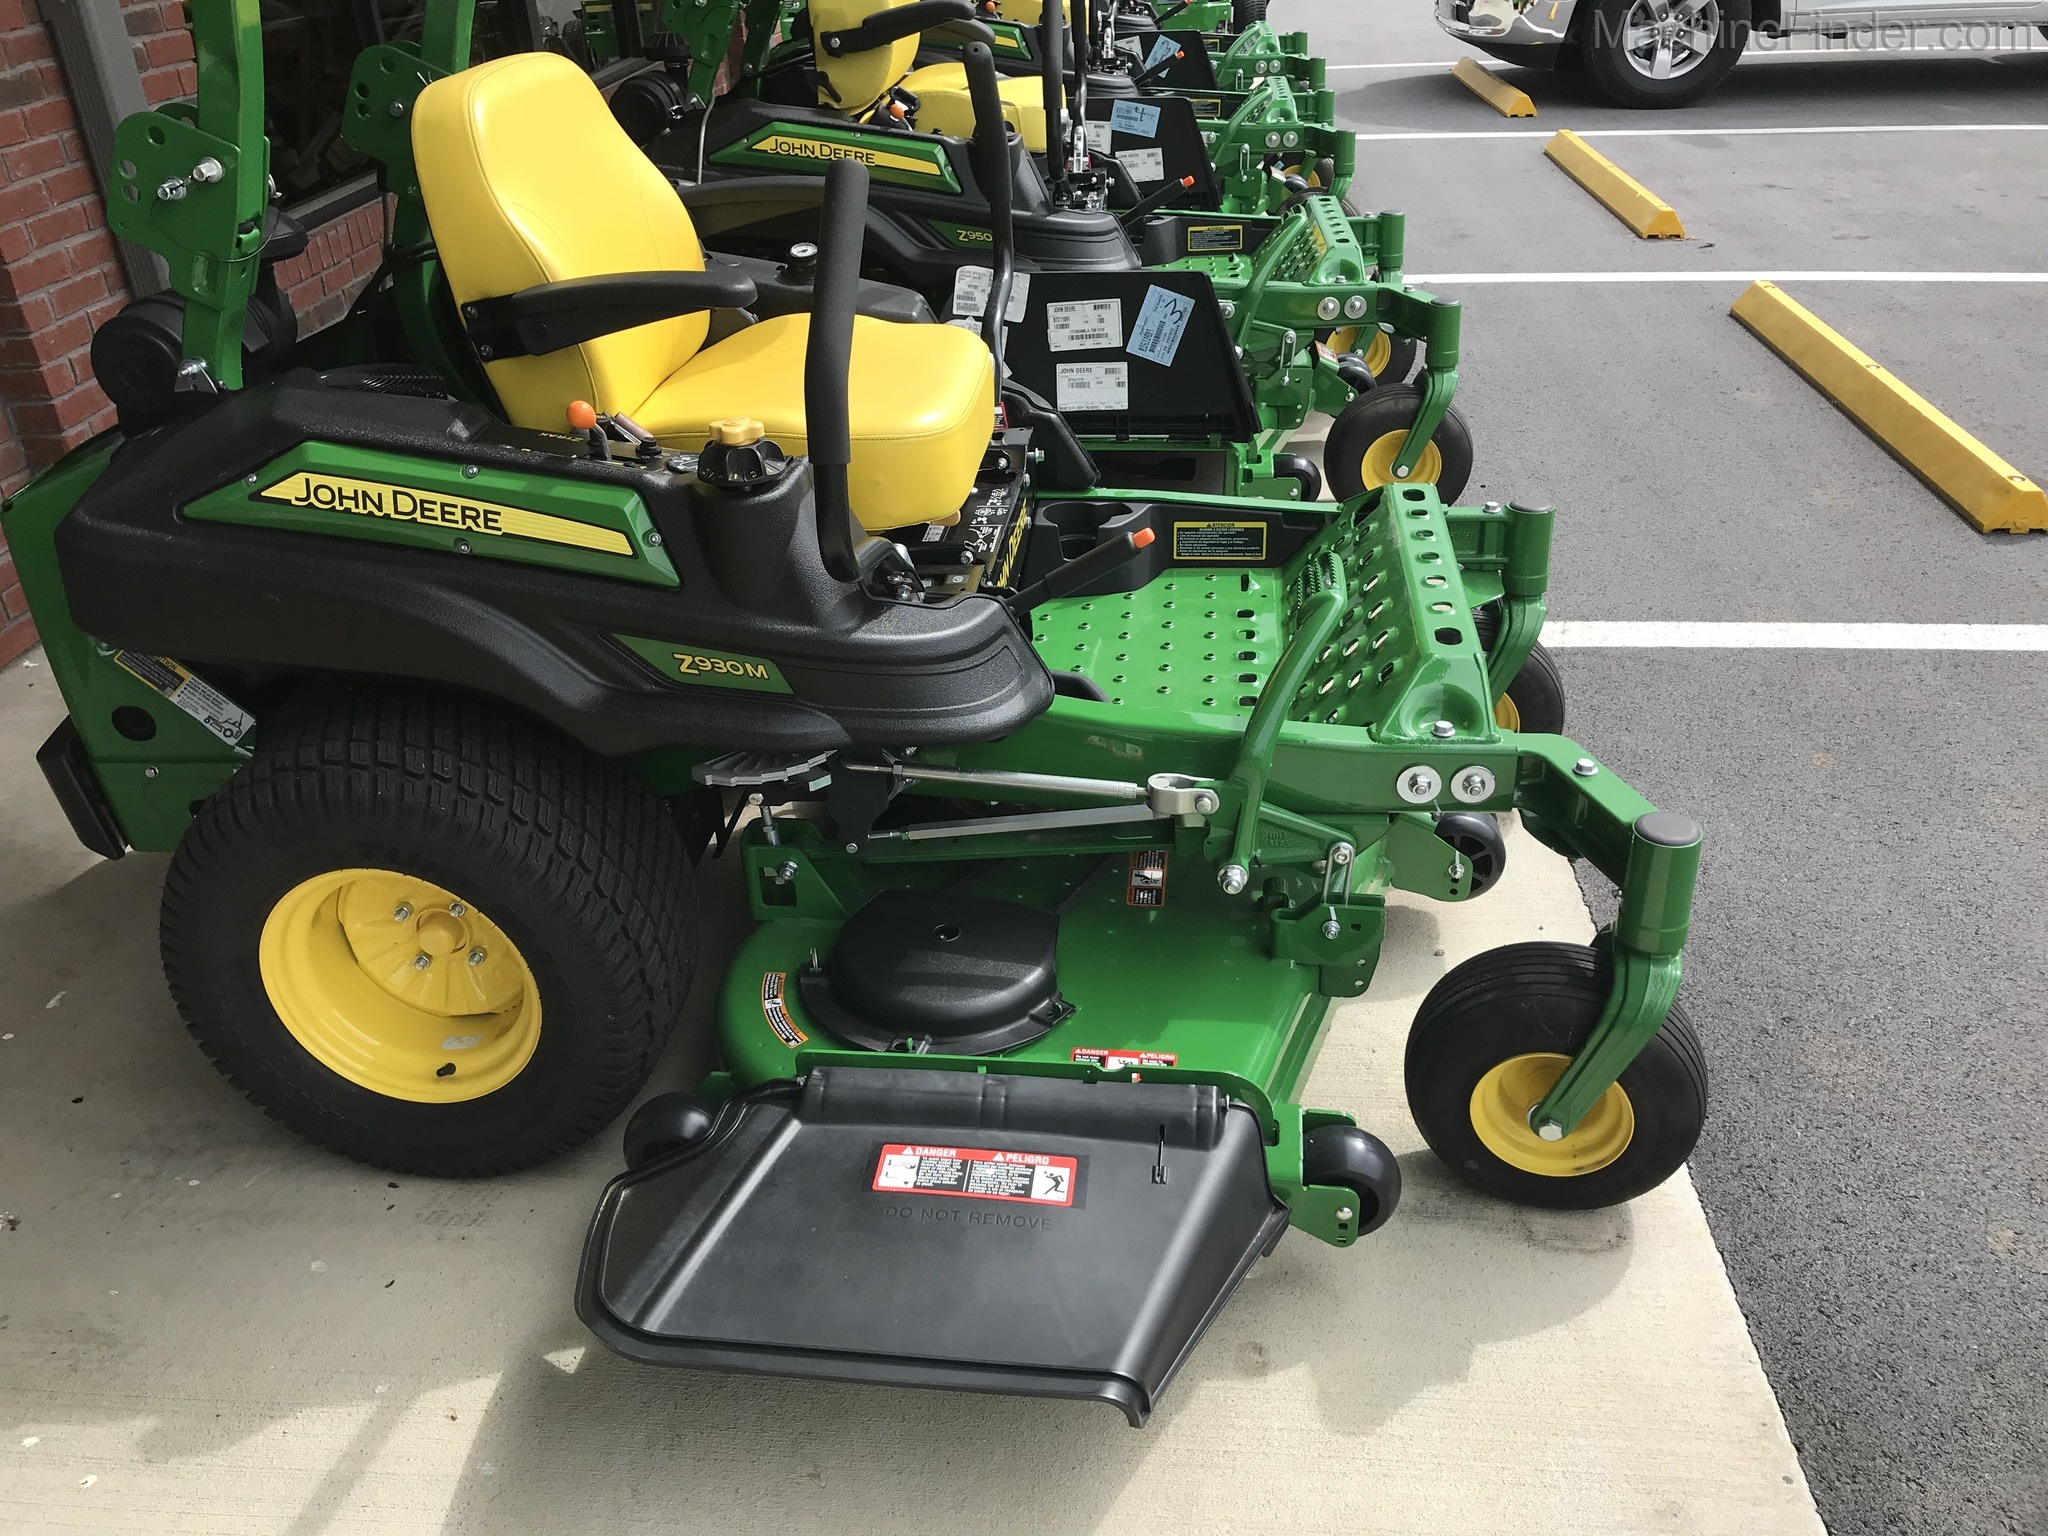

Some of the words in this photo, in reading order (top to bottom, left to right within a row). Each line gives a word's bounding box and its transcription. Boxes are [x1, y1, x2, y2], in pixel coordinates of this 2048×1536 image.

[769, 138, 815, 156] JOHN
[819, 143, 876, 164] DEERE
[1064, 305, 1076, 313] DEERE
[1075, 366, 1093, 374] DEERE
[294, 477, 385, 513] JOHN
[392, 489, 503, 532] DEERE
[672, 653, 769, 679] Z930M
[915, 1146, 957, 1158] DANGER
[1005, 1153, 1050, 1165] PELIGRO
[885, 1205, 913, 1219] DO
[921, 1208, 960, 1224] NOT
[968, 1211, 1052, 1231] REMOVE
